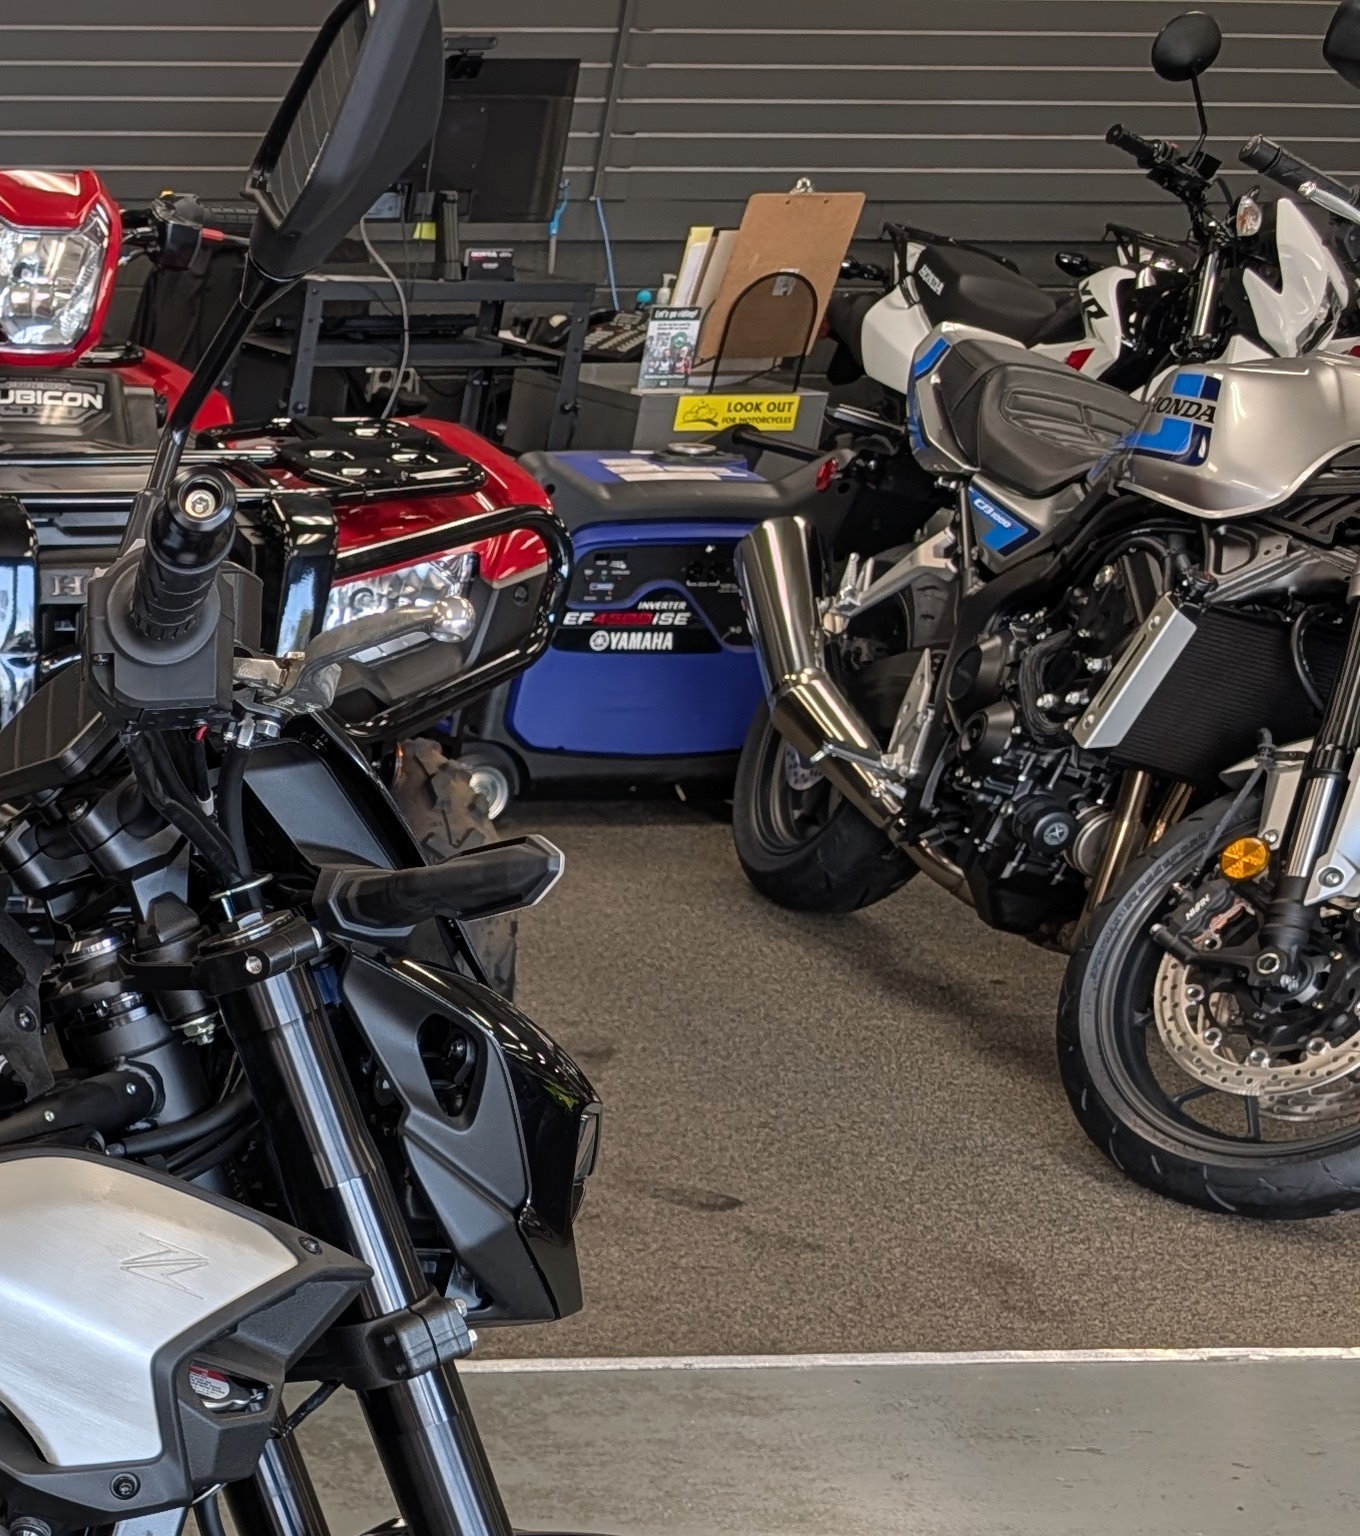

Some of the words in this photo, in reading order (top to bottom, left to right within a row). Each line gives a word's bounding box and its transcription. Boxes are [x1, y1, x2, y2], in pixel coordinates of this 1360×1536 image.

[726, 401, 764, 413] LOOK
[766, 401, 795, 413] OUT
[721, 415, 737, 424] FOR
[738, 415, 793, 425] MOTORCYCLES
[636, 601, 688, 611] INVERTER
[609, 631, 674, 651] YAMAHA
